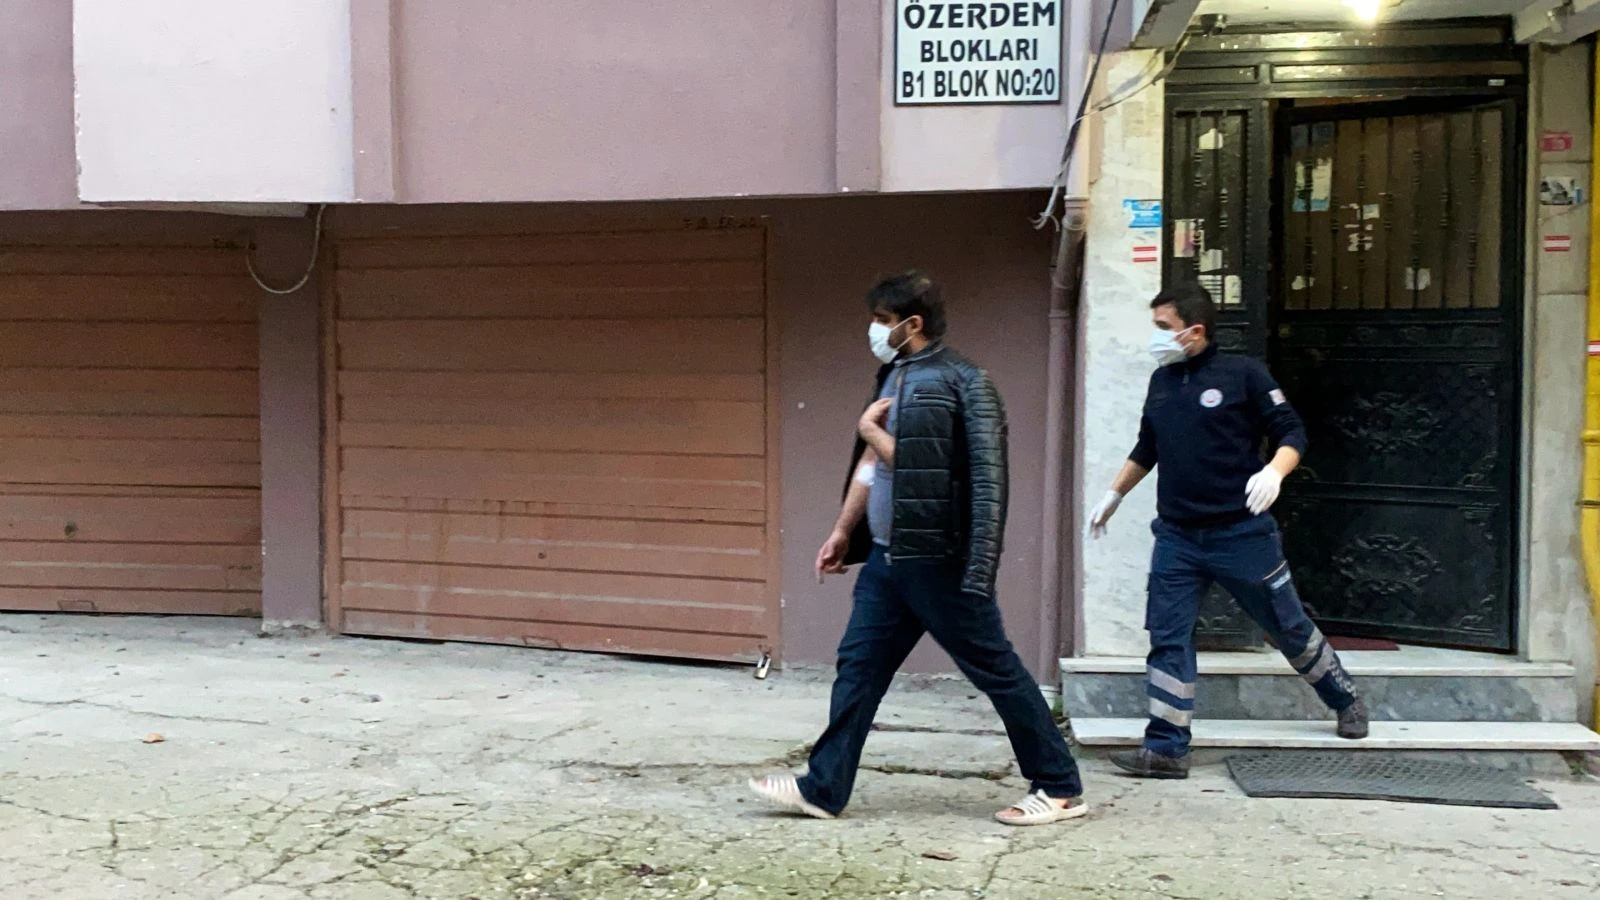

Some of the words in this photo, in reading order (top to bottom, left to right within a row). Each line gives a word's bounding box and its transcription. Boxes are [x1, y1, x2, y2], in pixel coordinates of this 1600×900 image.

[904, 0, 1055, 30] ÖZERDEM
[921, 38, 1038, 63] BLOKLARI
[902, 71, 925, 98] B1
[934, 69, 988, 97] BLOK
[996, 68, 1055, 96] NO:20
